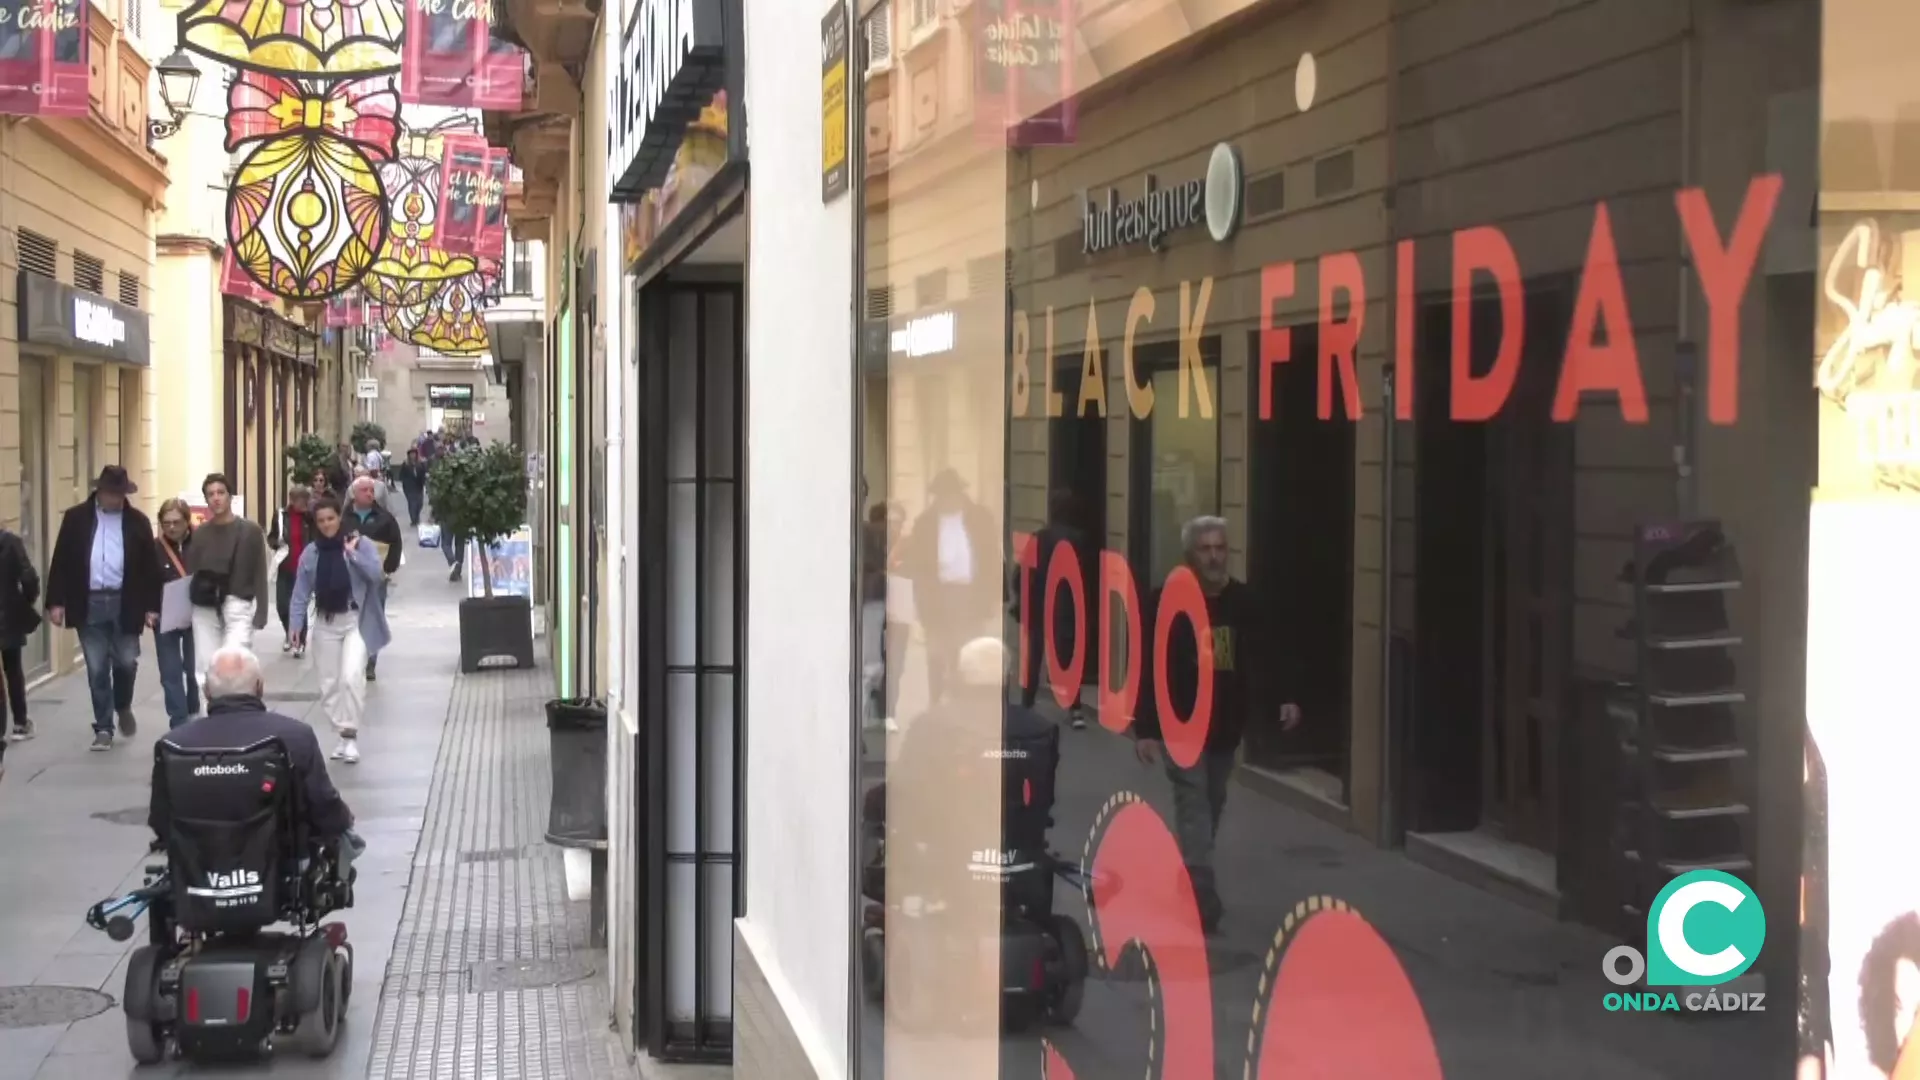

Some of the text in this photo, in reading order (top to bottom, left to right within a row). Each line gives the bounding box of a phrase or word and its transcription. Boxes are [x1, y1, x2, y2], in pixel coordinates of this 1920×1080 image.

[18, 5, 79, 32] Cádiz
[1011, 275, 1214, 421] BLACK
[1258, 172, 1784, 424] FRIDAY
[1012, 530, 1215, 769] TODO
[206, 869, 260, 888] Valls
